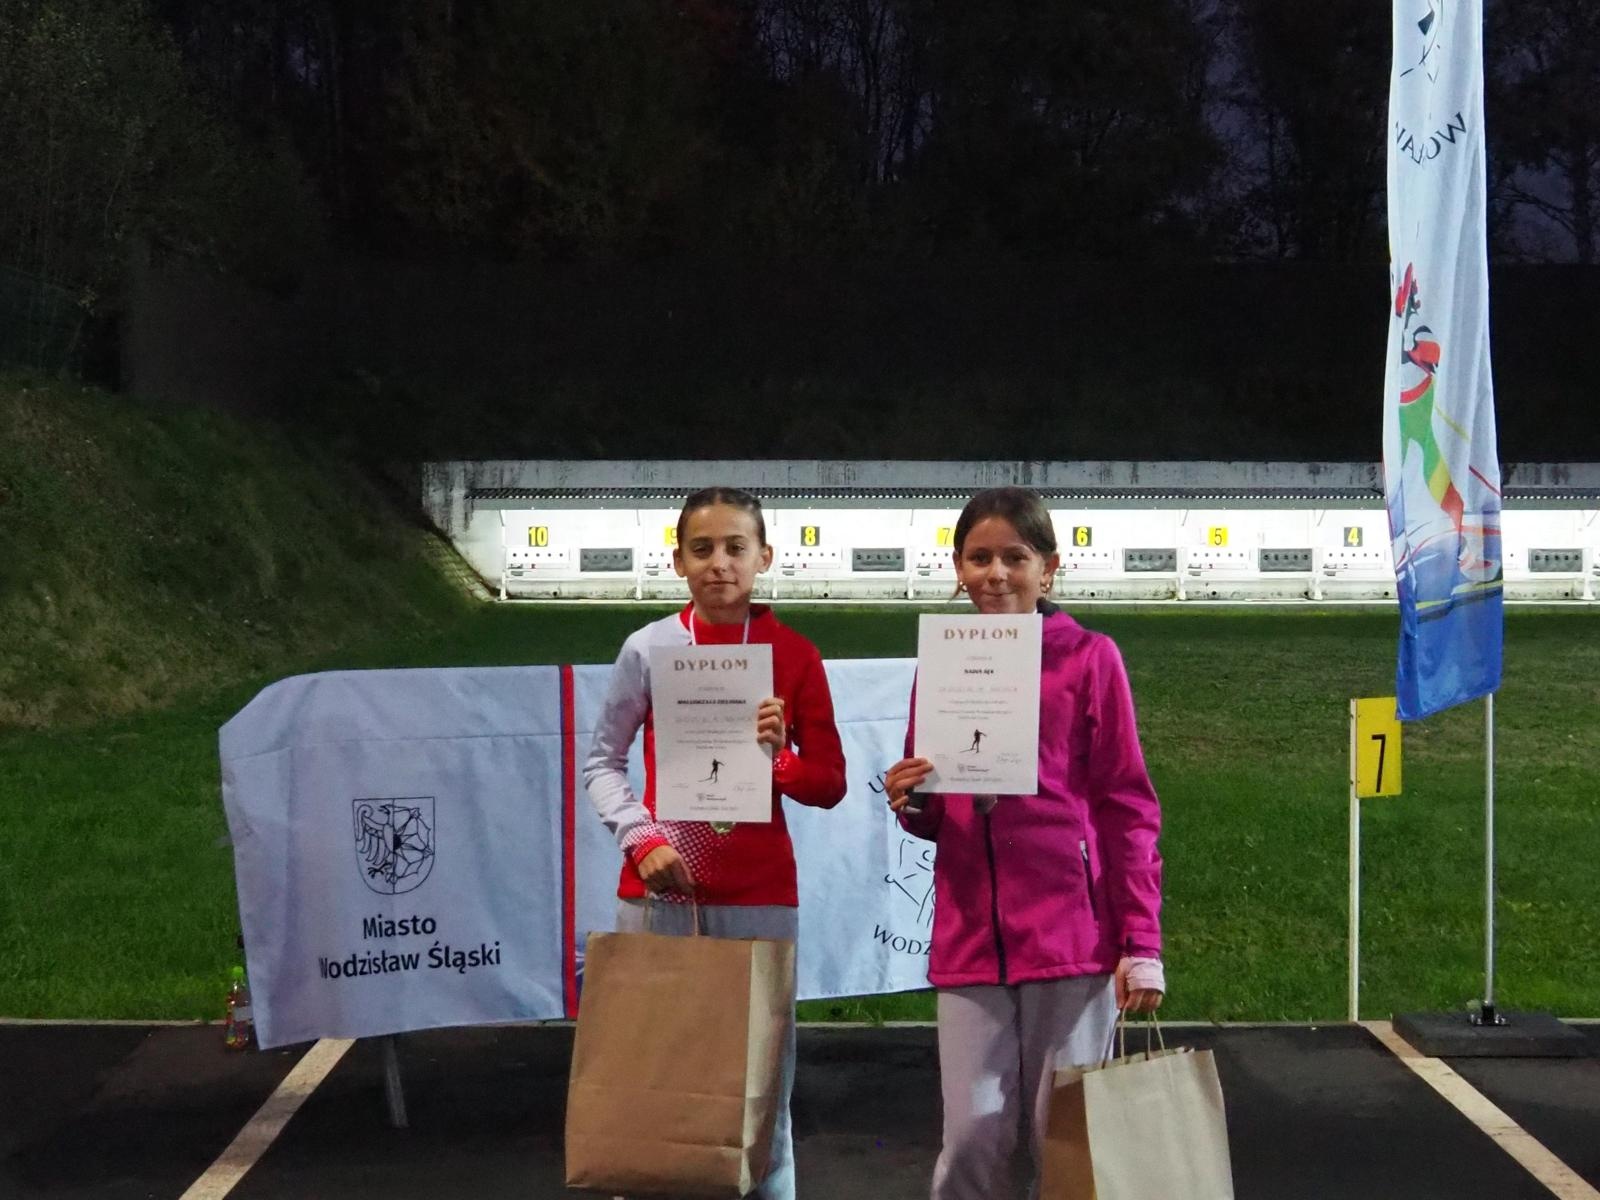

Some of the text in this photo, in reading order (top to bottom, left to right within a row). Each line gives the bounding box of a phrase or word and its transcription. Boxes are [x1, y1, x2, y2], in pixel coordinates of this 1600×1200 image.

[529, 526, 548, 547] 10
[804, 526, 816, 546] 8
[942, 527, 951, 545] 7
[1077, 526, 1088, 546] 6
[1214, 528, 1222, 545] 5
[1347, 526, 1359, 546] 4
[944, 628, 1018, 640] DYPLOM
[674, 659, 749, 672] DYPLOM
[1371, 734, 1386, 793] 7
[363, 914, 437, 939] Miasto
[427, 941, 501, 974] Śląski
